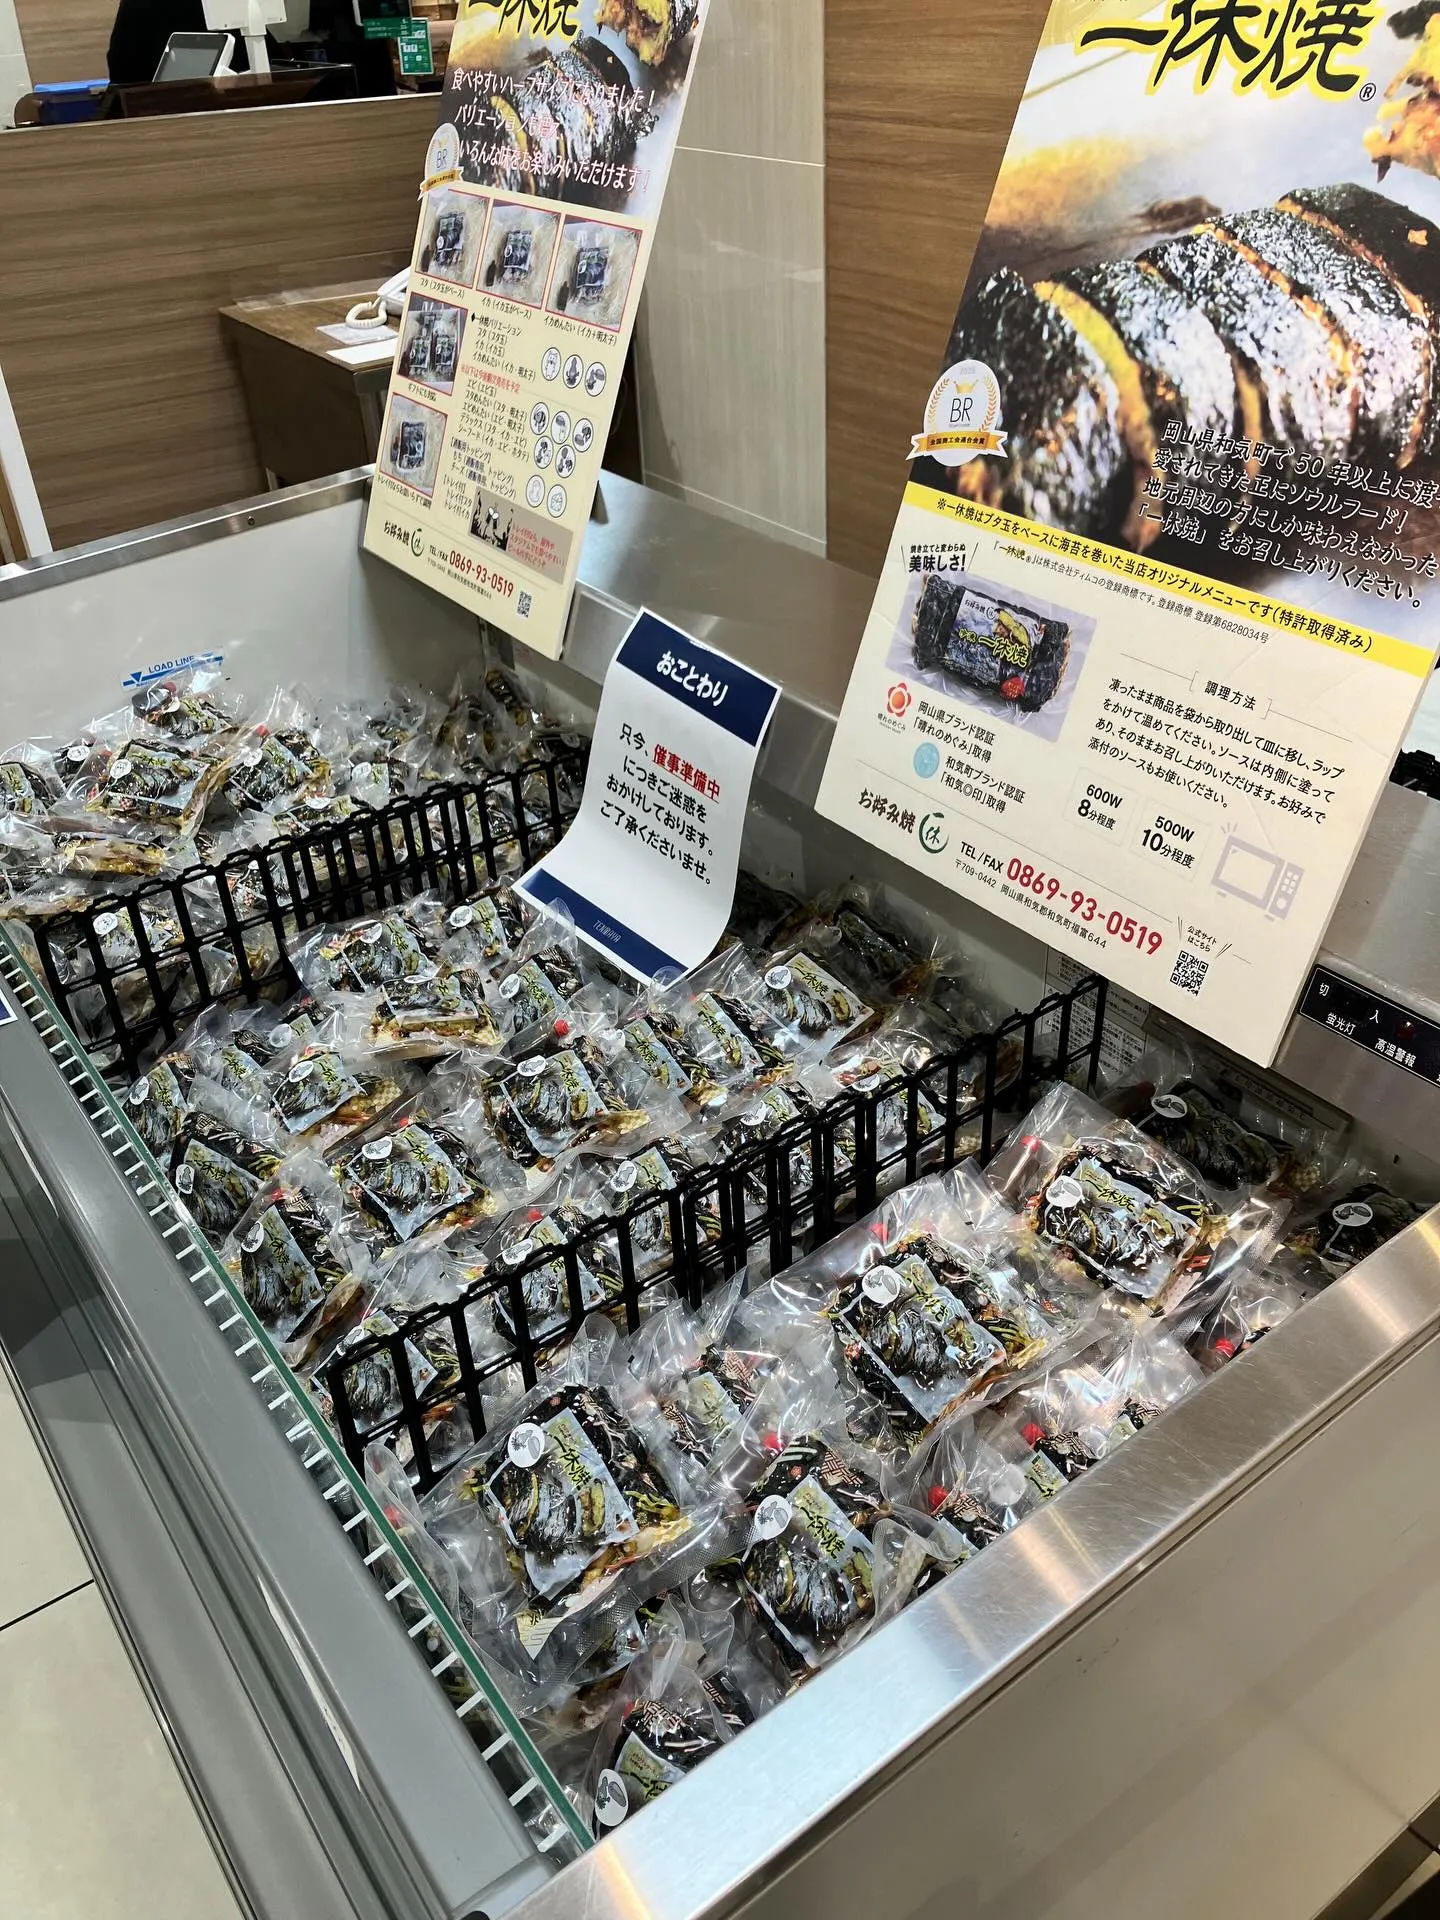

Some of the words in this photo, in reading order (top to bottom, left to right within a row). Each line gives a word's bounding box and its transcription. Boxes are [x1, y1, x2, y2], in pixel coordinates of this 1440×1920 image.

[949, 397, 973, 423] BR
[1161, 418, 1440, 508] 岡山県和気町で50年以上に渡
[1152, 448, 1409, 536] 愛されてきた正にソウルフード！
[910, 543, 966, 554] 焼き立てと変わらぬ
[1143, 476, 1440, 578] 地元周辺の方にしか味わえなかった
[450, 550, 514, 598] 0869-93-0519
[908, 554, 966, 573] 美味しさ!
[148, 661, 174, 674] LOAD
[978, 636, 1030, 668] 一休焼
[656, 650, 728, 707] おことわり
[1204, 680, 1256, 711] 調理方法
[913, 716, 992, 763] 「晴れのめぐみ」取得
[917, 701, 996, 746] 岡山県ブランド認証
[1108, 677, 1345, 780] 凍ったまま商品を袋から取り出して皿に移し、ラップ
[1087, 736, 1228, 809] 添付のソースもお使いください。
[1095, 717, 1327, 824] あり、そのままお召し上がりいただけます。お好みで
[1103, 698, 1335, 803] をかけて温めてください。ソースは内側に塗って
[623, 755, 708, 824] につきご迷惑を
[945, 756, 1026, 804] 和気町ブランド認証
[1086, 784, 1123, 809] 600W
[606, 773, 714, 857] おかけしております。
[858, 787, 916, 833] お好み焼
[1078, 799, 1117, 830] 8分程度
[1155, 815, 1195, 843] 500W
[600, 801, 712, 885] ご了承くださいませ。
[1140, 828, 1196, 869] 10分程度
[1000, 883, 1108, 949] 岡山県和気郡和気町福富644
[1006, 857, 1163, 955] 0869-93-0519
[1187, 924, 1218, 946] 公式サイト
[1187, 935, 1212, 953] はこちら
[1319, 982, 1330, 997] 切
[1325, 1012, 1356, 1036] 蛍光灯
[1369, 1009, 1379, 1024] 入
[1374, 1038, 1417, 1068] 高温警報
